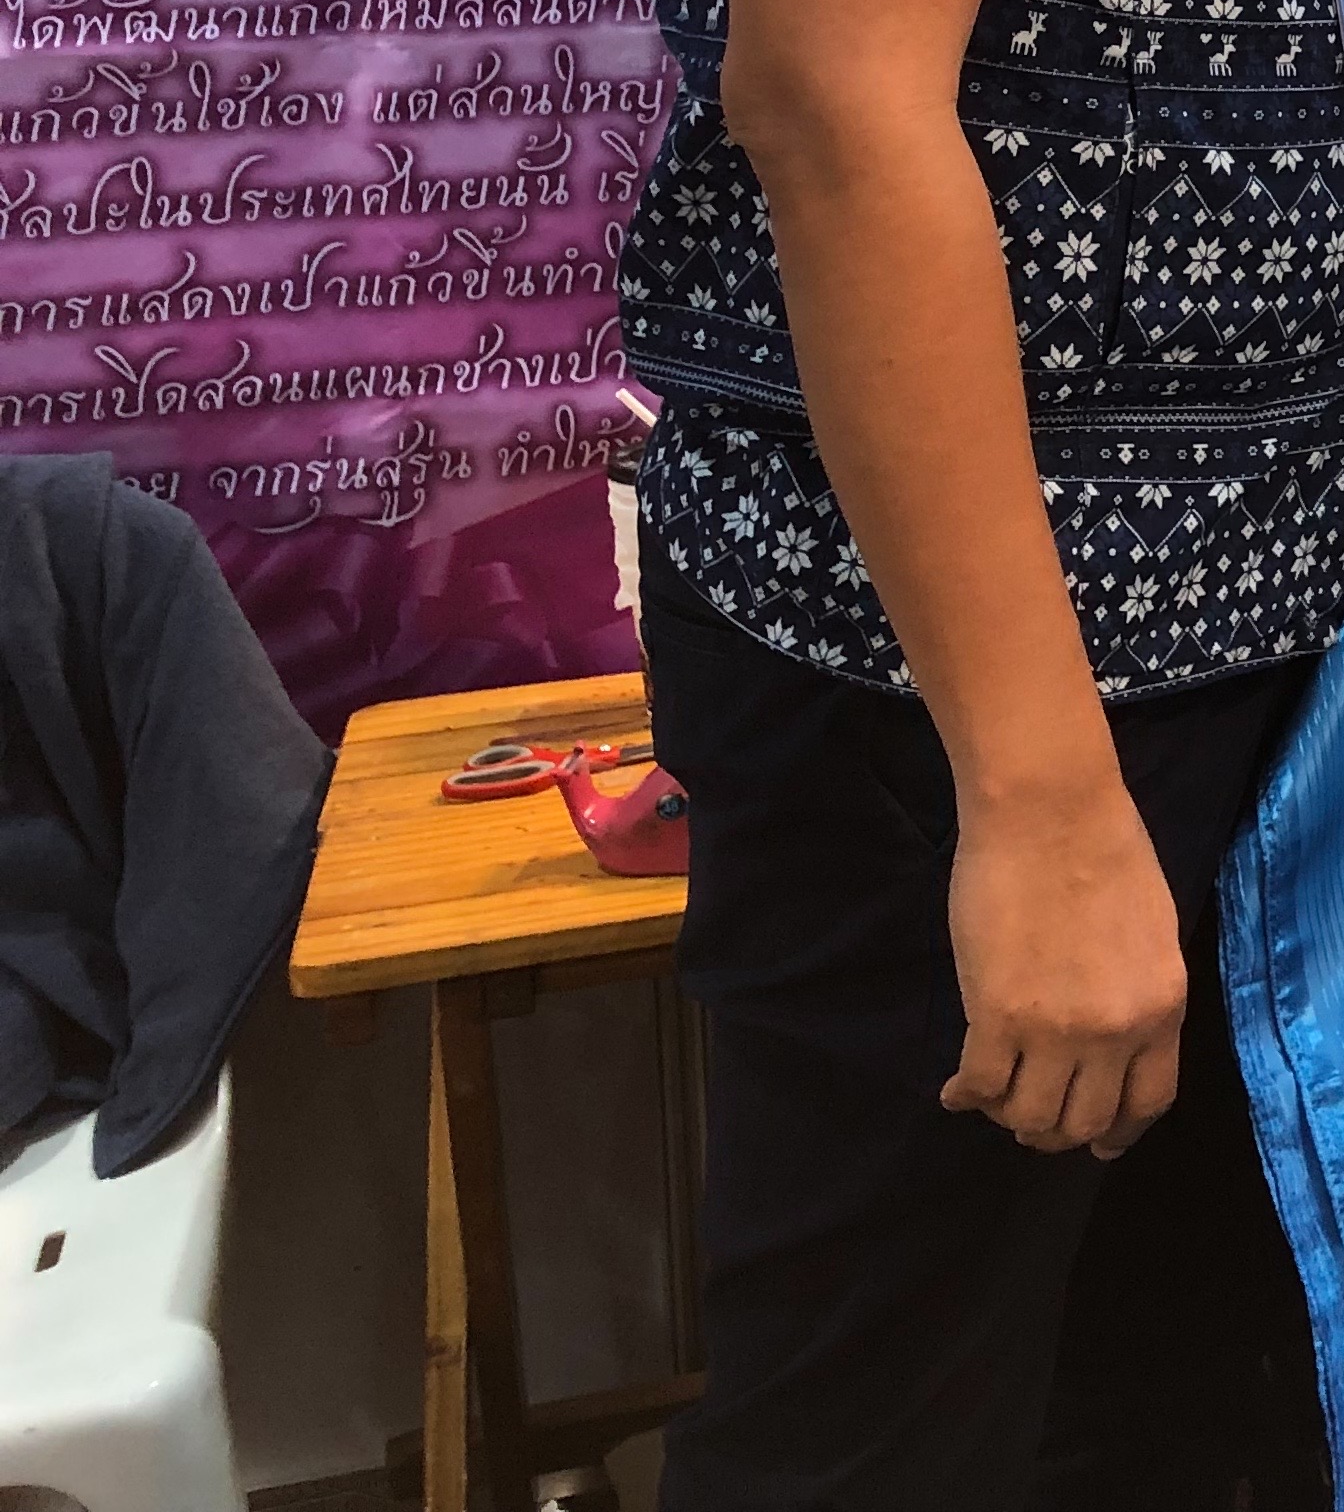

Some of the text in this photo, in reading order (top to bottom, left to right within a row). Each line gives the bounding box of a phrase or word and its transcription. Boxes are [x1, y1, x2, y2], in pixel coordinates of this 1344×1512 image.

[371, 44, 668, 125] แต่ส่วนใหญ่
[208, 420, 472, 535] จากรุ่นสู่รุ่น
